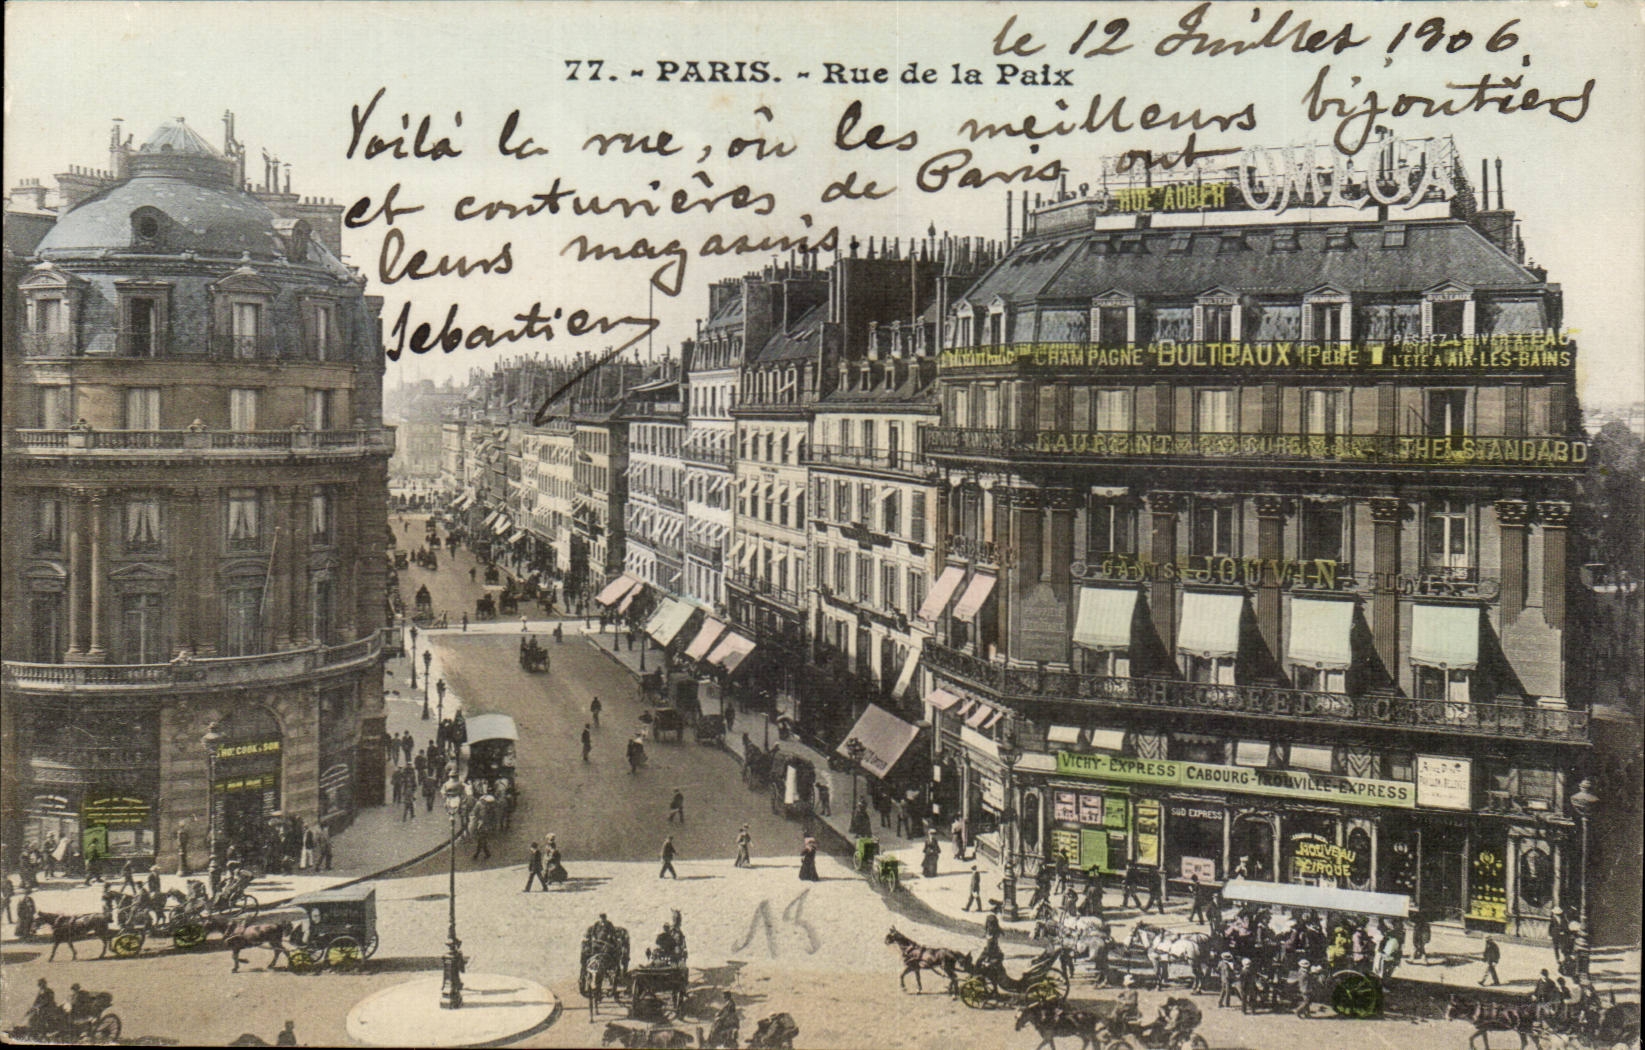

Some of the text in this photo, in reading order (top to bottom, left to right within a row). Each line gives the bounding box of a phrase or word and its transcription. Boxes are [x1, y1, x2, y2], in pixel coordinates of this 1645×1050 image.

[993, 14, 1042, 57] le
[1069, 18, 1131, 58] 12
[498, 108, 549, 160] la
[835, 99, 918, 151] les
[958, 95, 1258, 142] meilleurs
[344, 183, 425, 229] et
[820, 171, 898, 204] de
[916, 144, 1066, 194] Paris
[1117, 187, 1155, 212] RUE
[1162, 183, 1226, 211] AUBER
[379, 228, 513, 285] leurs
[1034, 348, 1144, 367] CHAMPAGNE
[1447, 351, 1572, 368] AIX-LES-BAINS
[1400, 438, 1446, 460] THE
[1462, 438, 1588, 463] STANDARD
[1101, 559, 1175, 580] GANTS
[1196, 556, 1338, 590] JOUVIN
[1061, 753, 1176, 777] VICHY-EXPRESS
[1186, 765, 1408, 800] CABOURG-TROUVILLE-EXPRESS
[1171, 807, 1223, 820] SUD EXPRESS
[1298, 842, 1357, 863] NOUVEAU
[1302, 859, 1352, 876] CIRQUE
